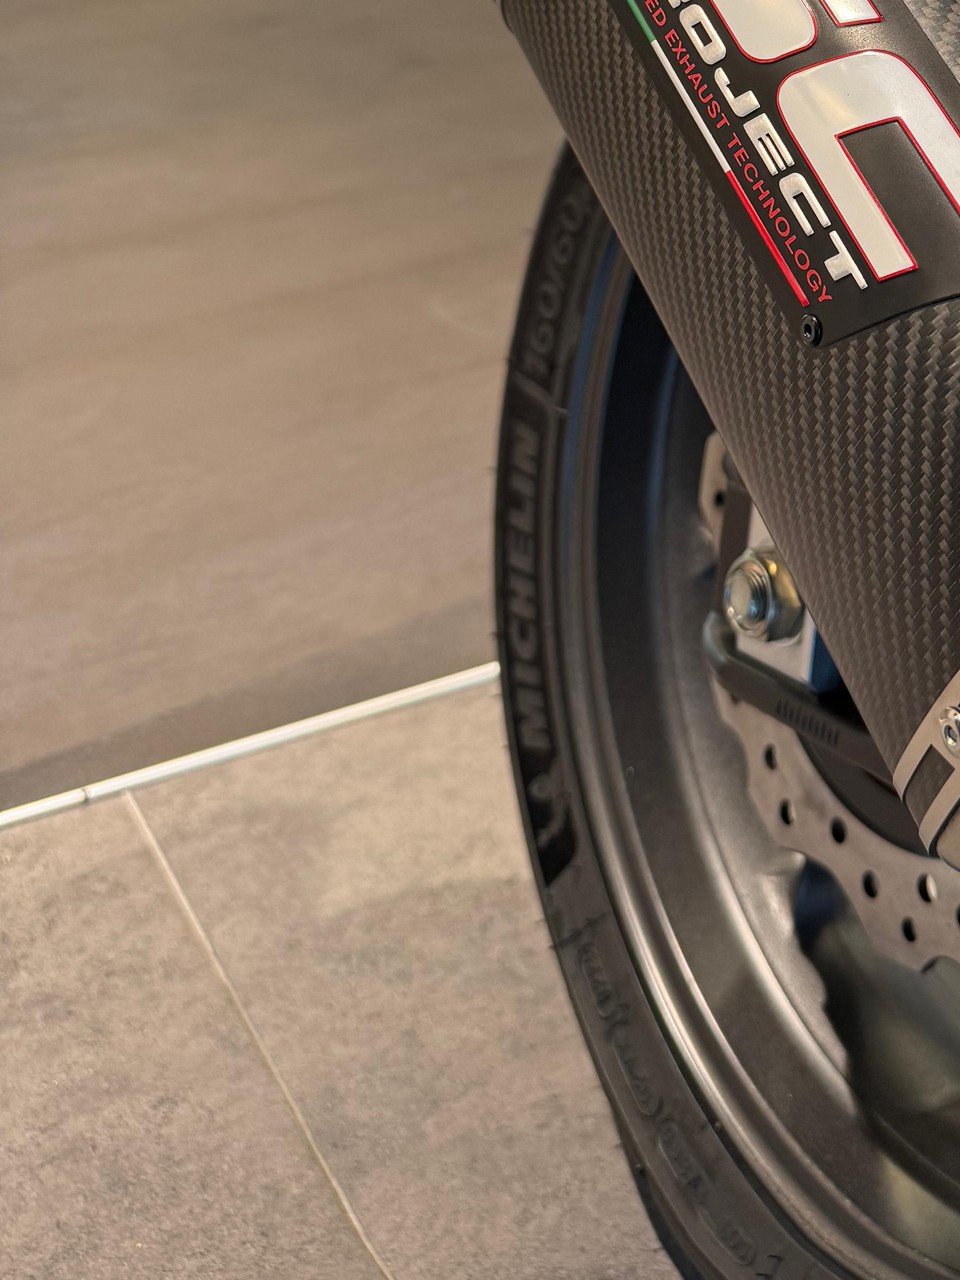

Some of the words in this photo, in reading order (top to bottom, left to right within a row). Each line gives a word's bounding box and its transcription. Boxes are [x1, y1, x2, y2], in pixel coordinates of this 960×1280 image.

[664, 28, 730, 128] EXHAUST
[726, 131, 832, 304] TECHNOLOGY
[504, 421, 554, 751] MICHELIN
